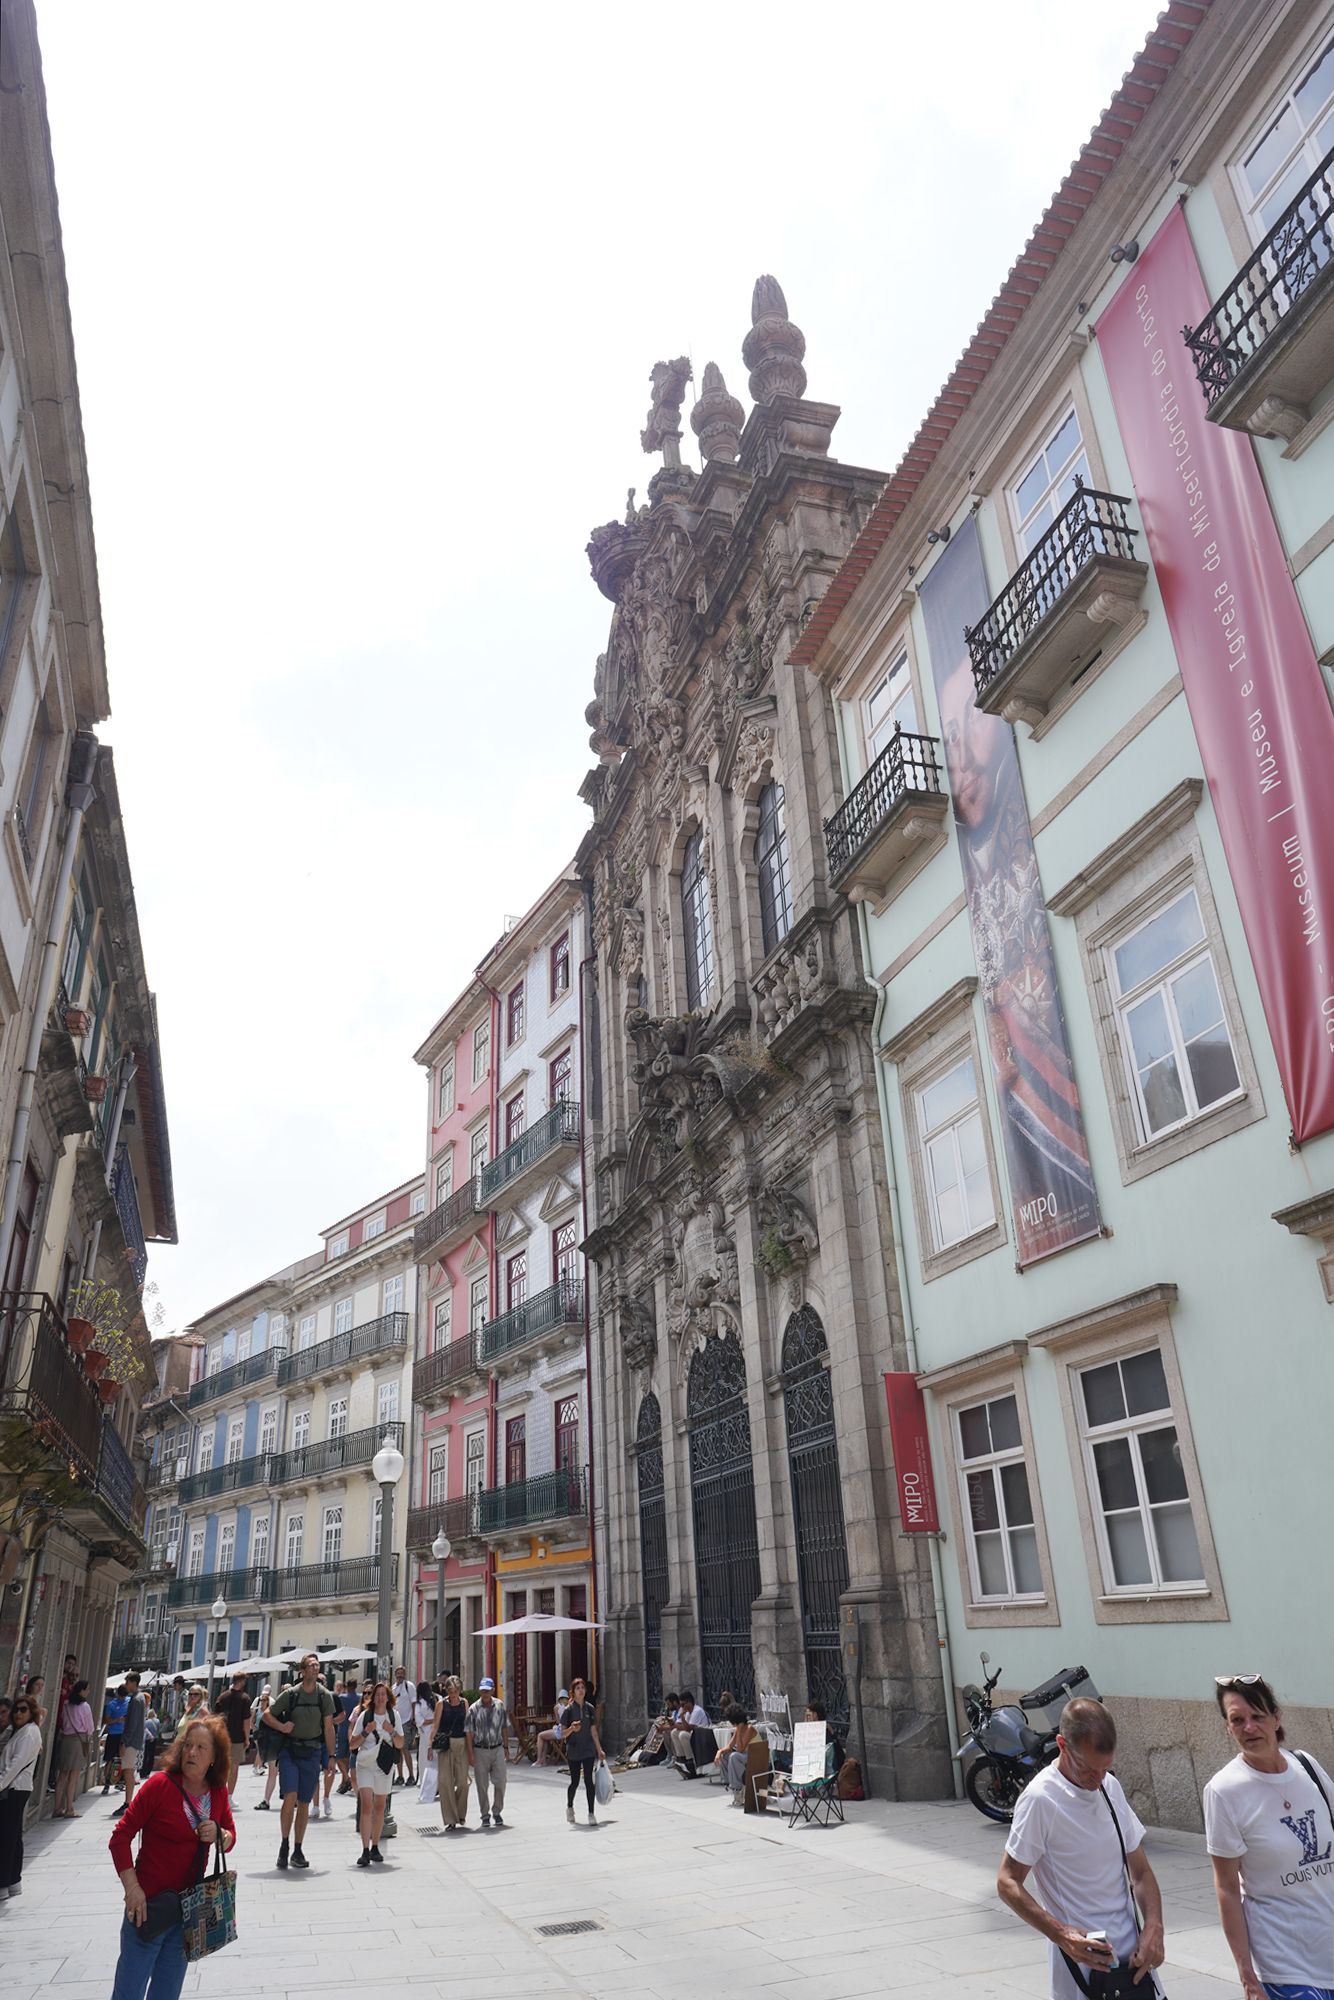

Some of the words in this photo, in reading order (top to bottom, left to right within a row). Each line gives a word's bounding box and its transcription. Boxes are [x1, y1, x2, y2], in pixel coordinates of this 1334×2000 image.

[1135, 284, 1158, 348] Porto
[1151, 348, 1167, 376] do
[1160, 381, 1210, 538] Misericórdia
[1202, 540, 1220, 572] da
[1214, 580, 1247, 672] Igreja
[1240, 679, 1254, 697] e
[1247, 708, 1282, 795] Museu
[1281, 834, 1321, 946] Museum
[1019, 1192, 1058, 1231] MIPO
[902, 1472, 924, 1523] MIPO
[1280, 1868, 1312, 1886] LOUIS
